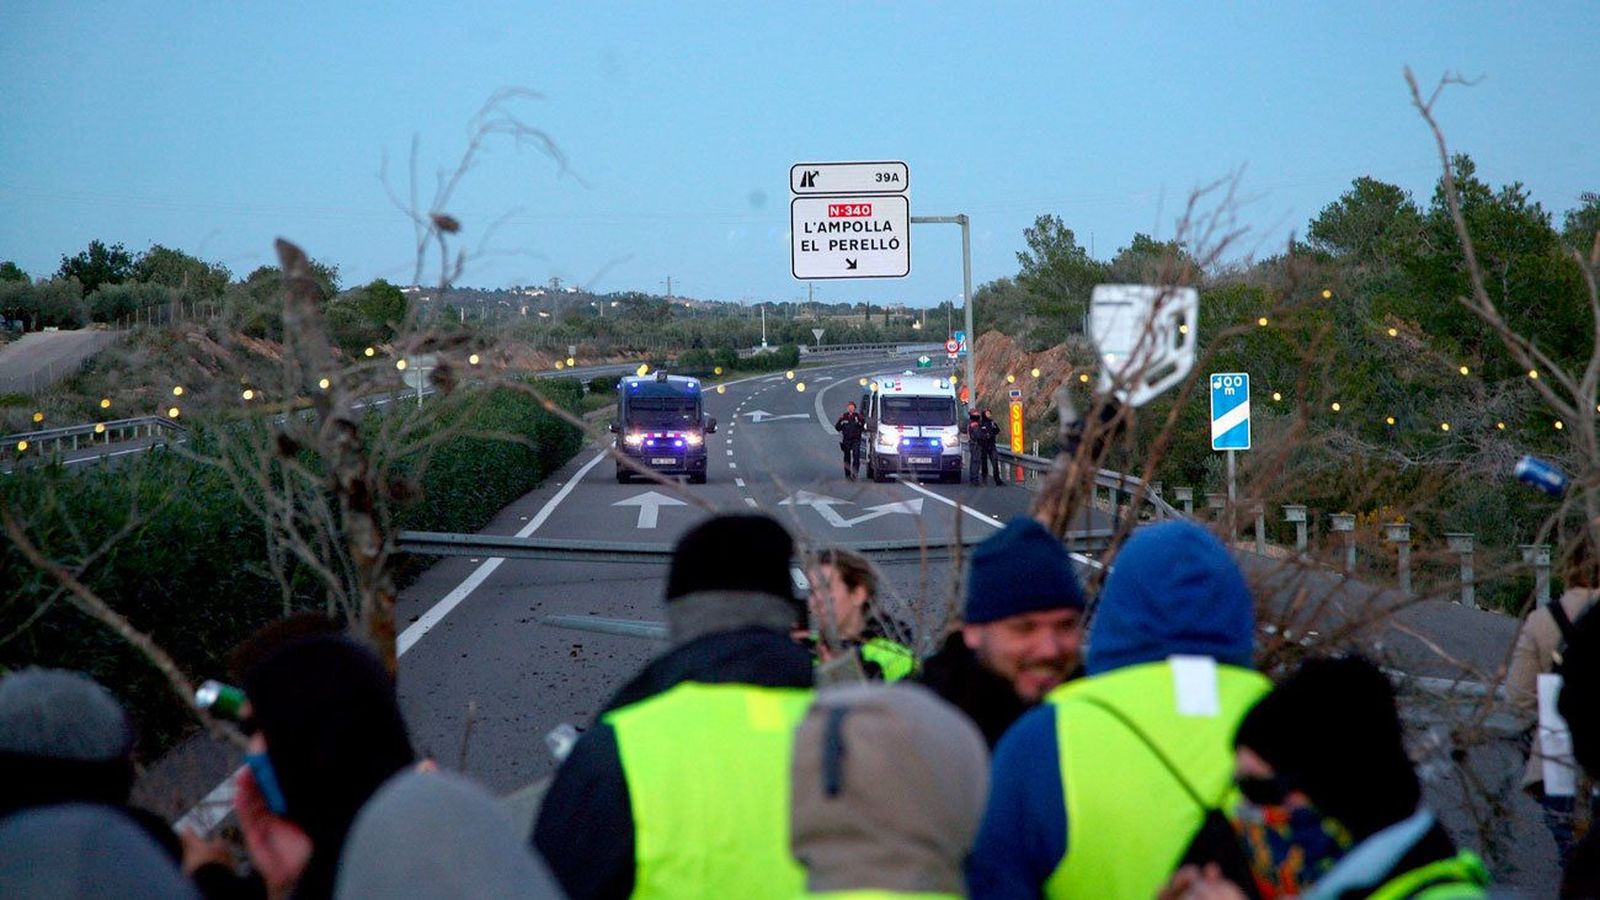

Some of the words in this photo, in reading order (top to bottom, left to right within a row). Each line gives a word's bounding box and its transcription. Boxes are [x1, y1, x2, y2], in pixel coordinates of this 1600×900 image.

[875, 172, 900, 183] 39A
[829, 205, 871, 215] N-340
[804, 220, 893, 233] L'AMPOLLA
[801, 240, 819, 252] EL
[829, 236, 900, 251] PERELLÓ
[1224, 387, 1235, 396] m
[1012, 404, 1021, 452] SOS
